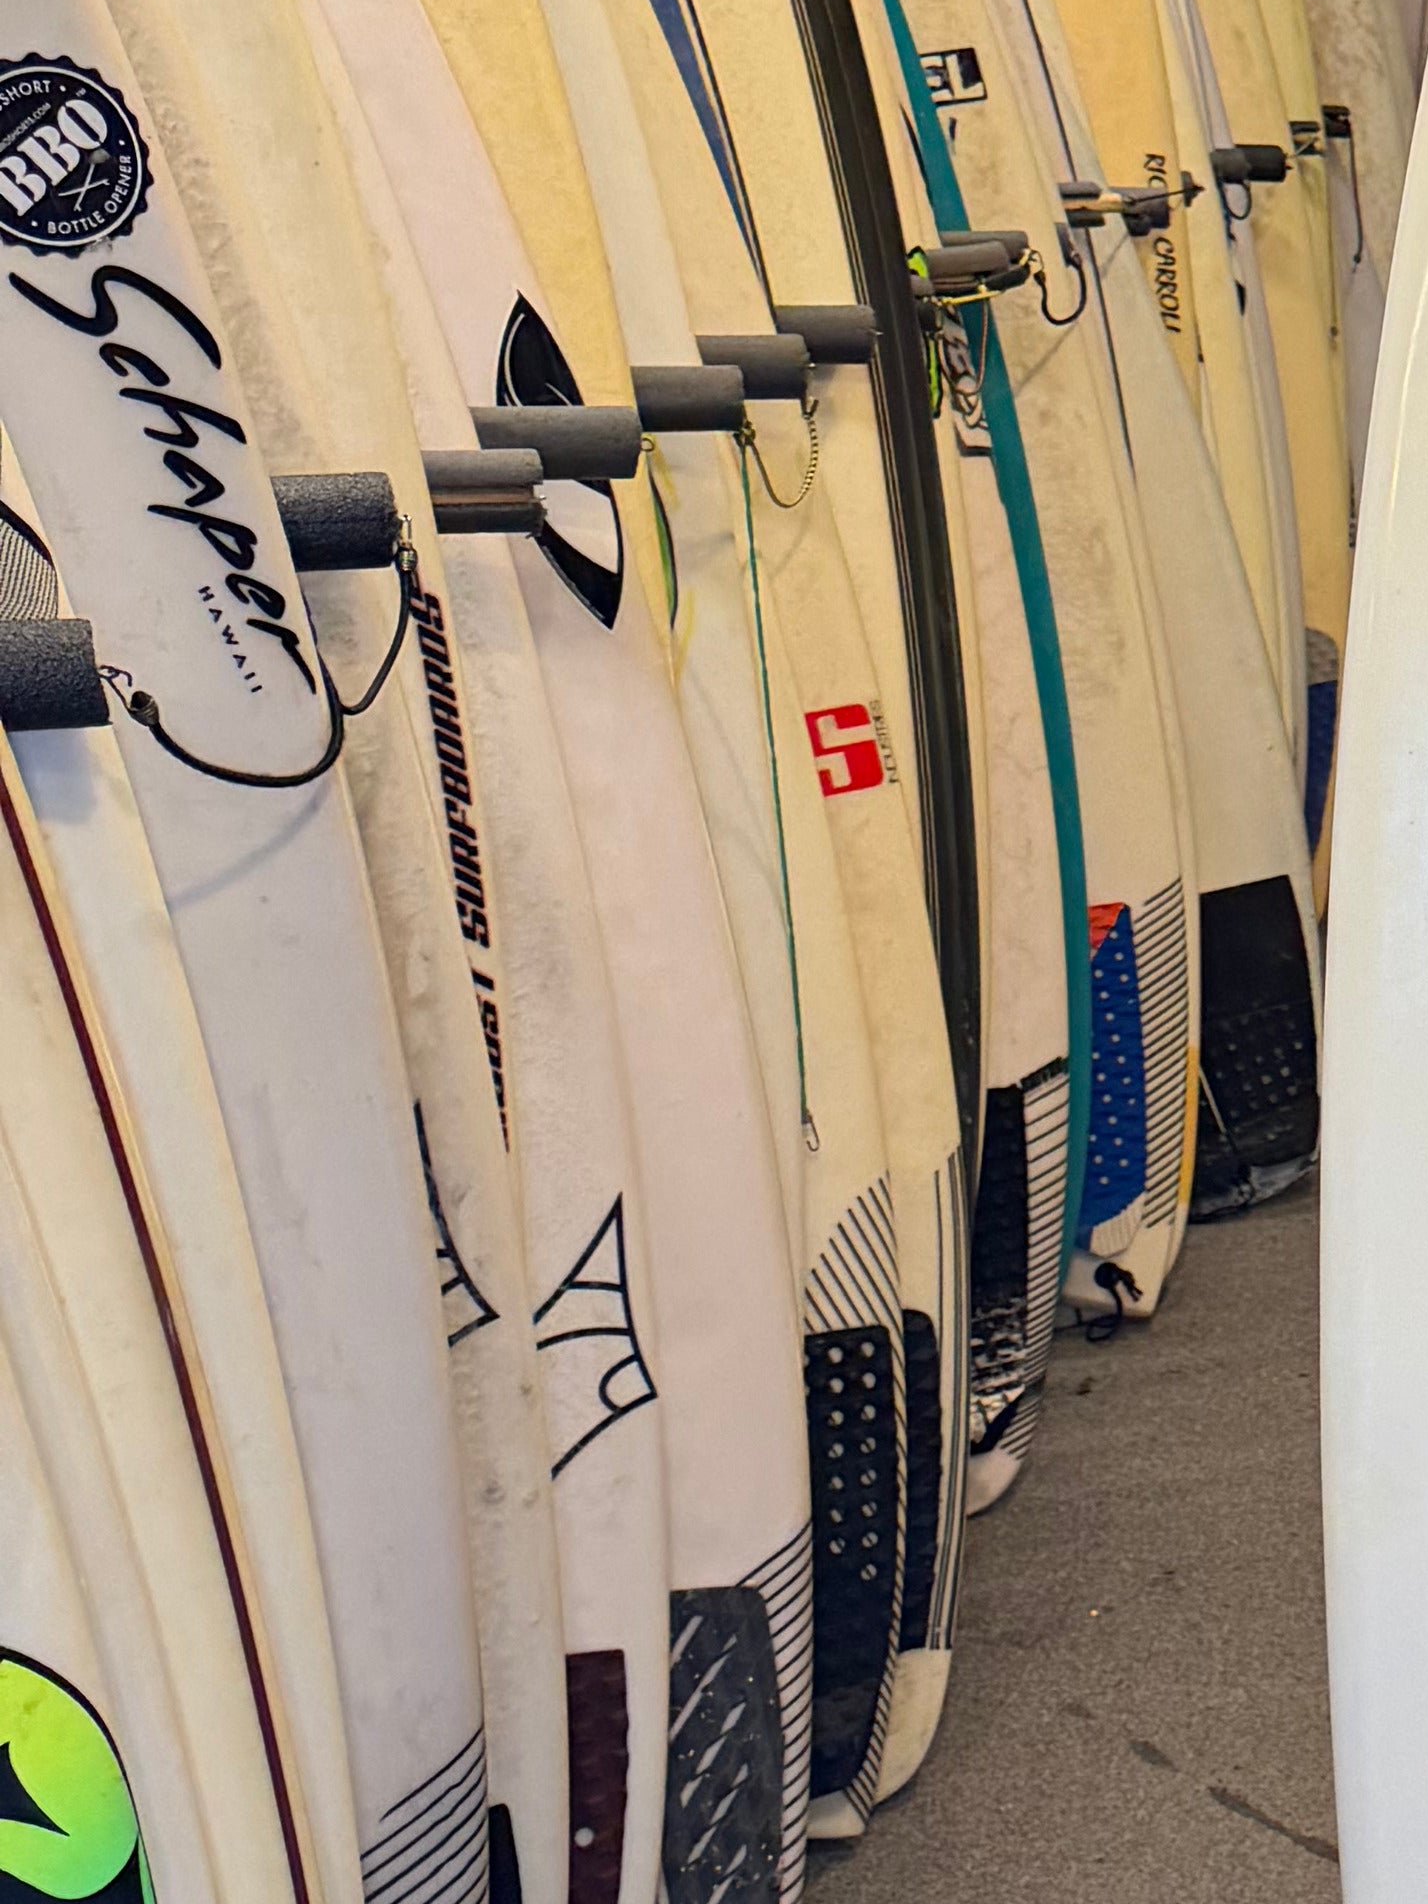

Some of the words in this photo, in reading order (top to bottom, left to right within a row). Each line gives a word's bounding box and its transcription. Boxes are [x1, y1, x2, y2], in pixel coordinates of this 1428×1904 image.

[0, 99, 108, 217] BBO
[47, 210, 105, 235] BOTTLE
[104, 155, 132, 214] OPENER
[10, 264, 316, 695] Schaper
[199, 586, 263, 694] HAWAII
[410, 592, 490, 948] SURFBOARDS
